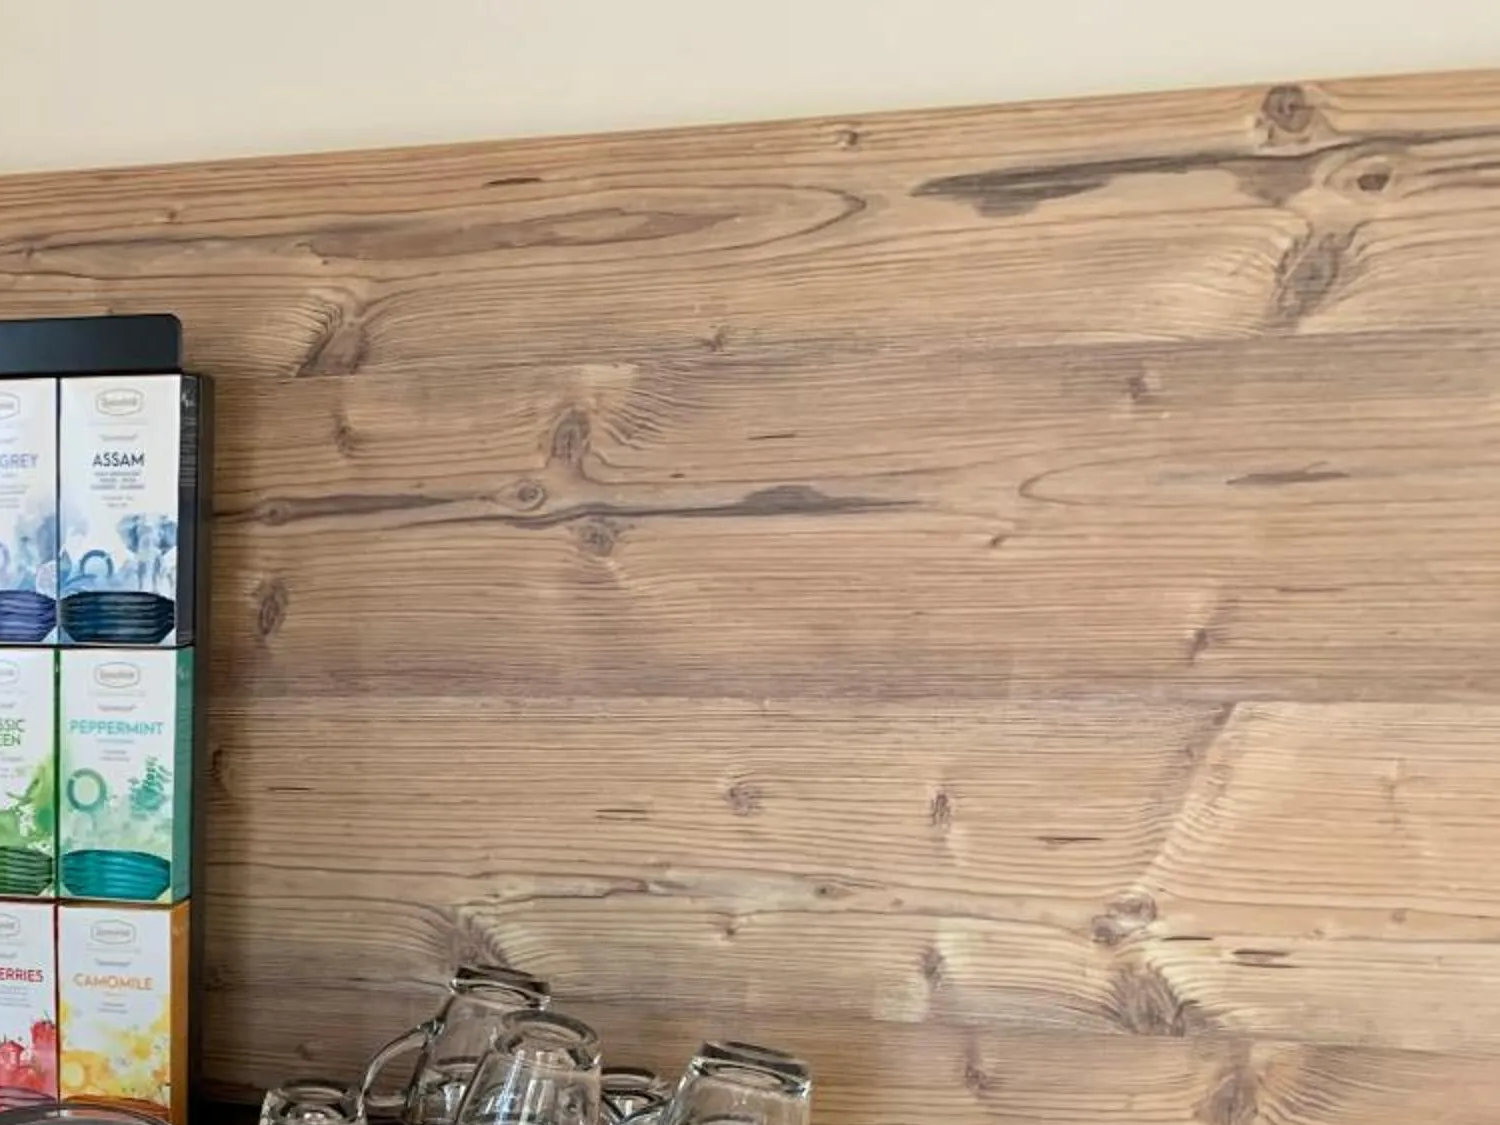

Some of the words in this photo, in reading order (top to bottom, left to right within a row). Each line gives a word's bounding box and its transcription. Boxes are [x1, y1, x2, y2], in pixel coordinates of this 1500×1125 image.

[91, 451, 146, 468] ASSAM
[69, 718, 165, 735] PEPPERMINT
[73, 973, 154, 991] CAMOMILE
